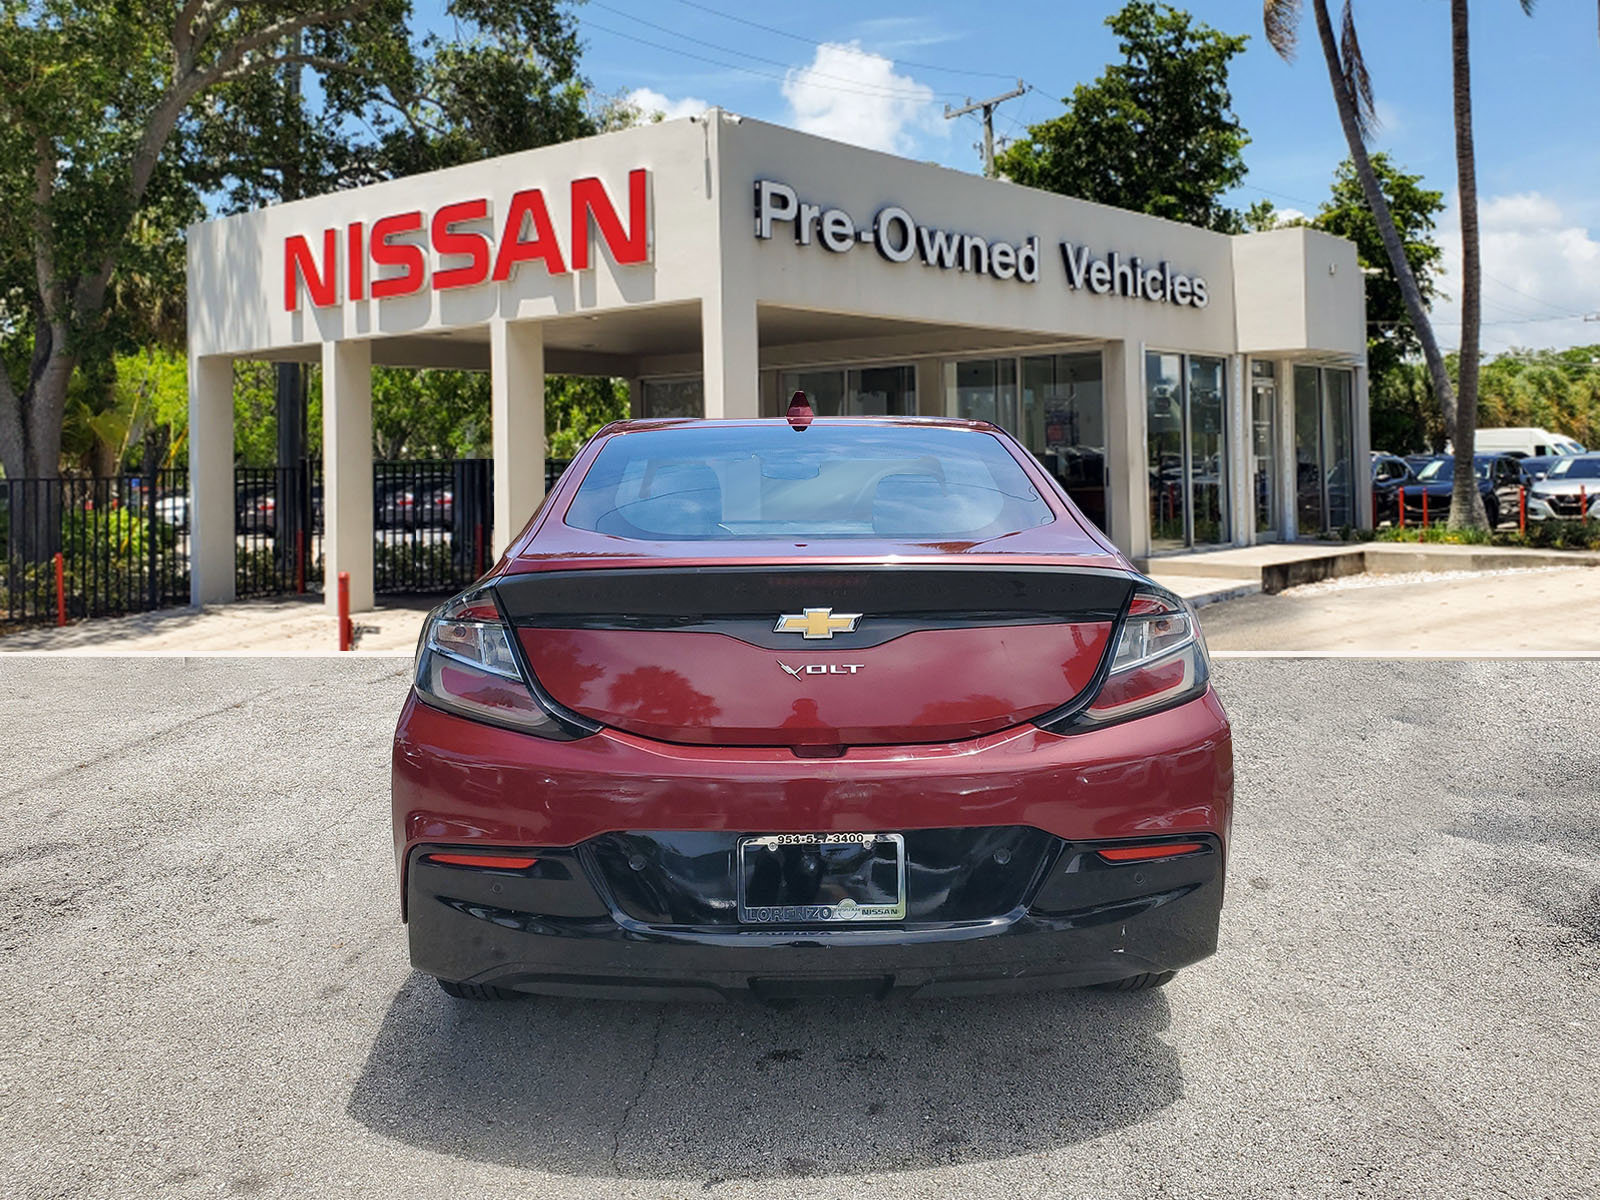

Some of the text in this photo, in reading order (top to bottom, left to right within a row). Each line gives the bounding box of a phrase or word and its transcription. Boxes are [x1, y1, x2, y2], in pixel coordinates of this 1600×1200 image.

[285, 168, 647, 312] NISSAN
[754, 180, 1209, 308] Pre-Owned Vehicles
[776, 659, 865, 680] VOLT
[747, 907, 832, 920] LORENZO
